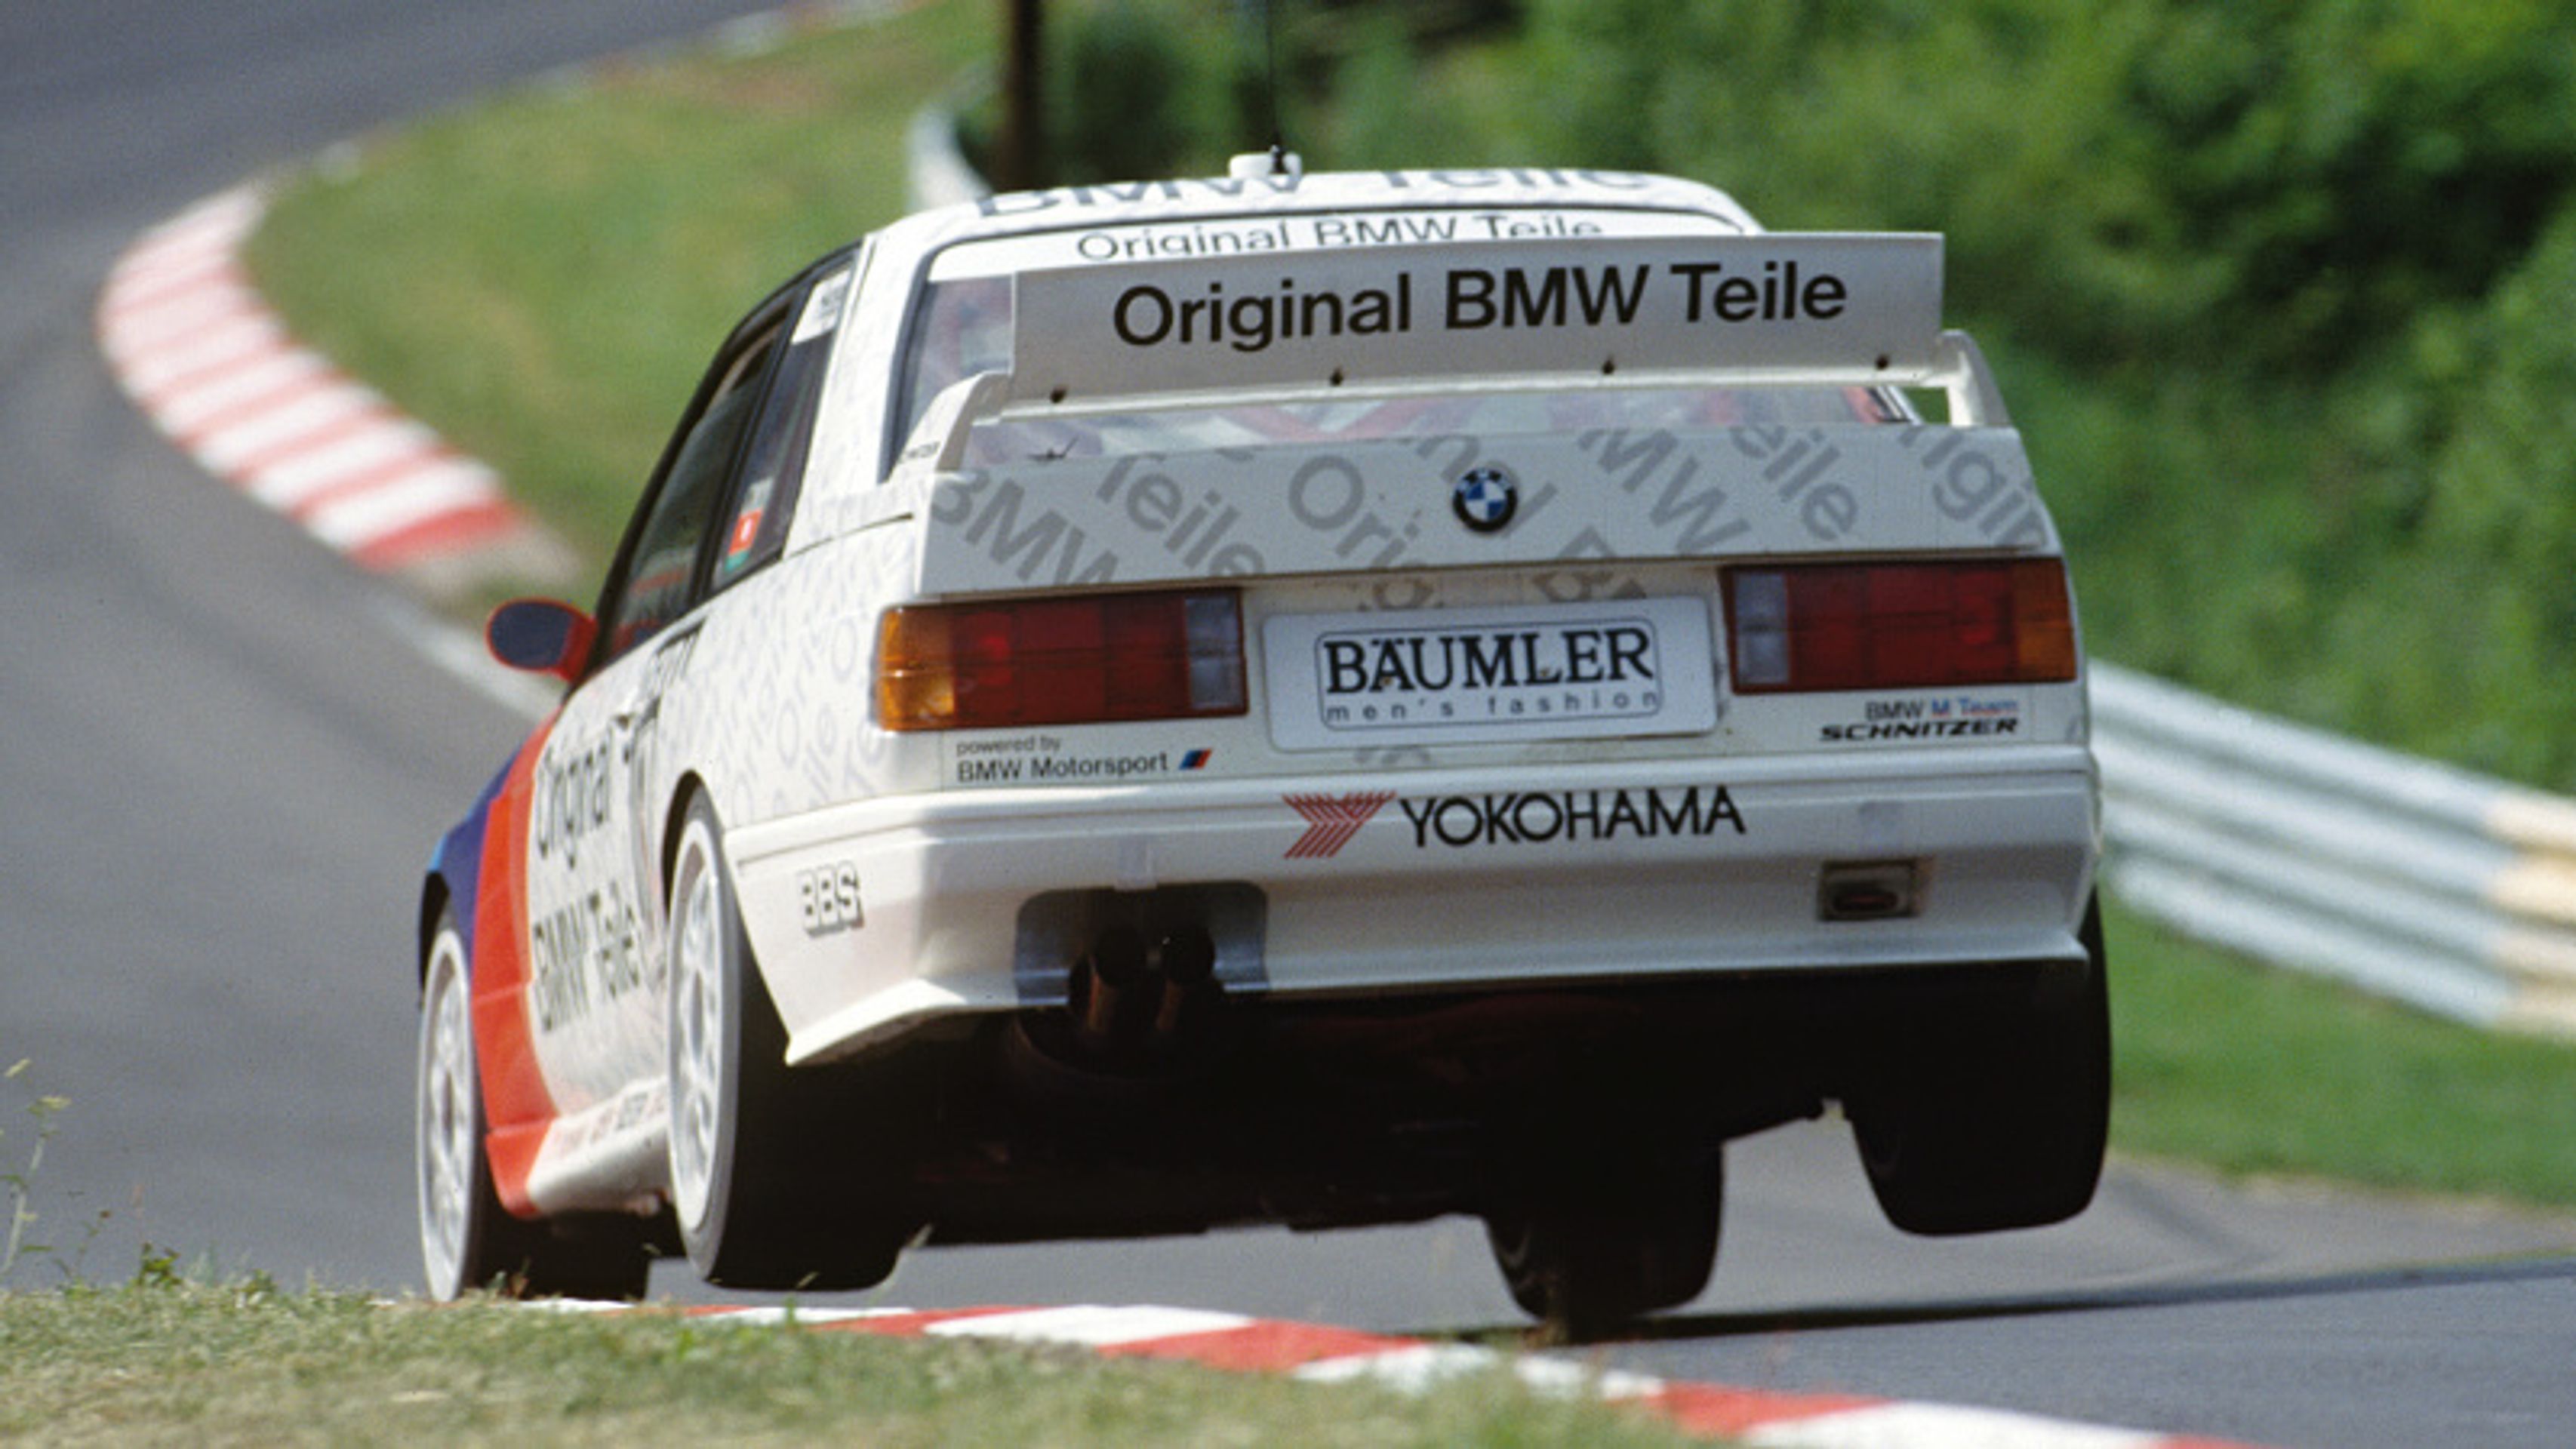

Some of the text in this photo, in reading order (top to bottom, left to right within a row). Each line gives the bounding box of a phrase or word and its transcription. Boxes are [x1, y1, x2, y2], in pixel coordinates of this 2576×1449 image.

[1314, 217, 1457, 247] BMW
[1113, 261, 1848, 352] Original BMW Teile
[1323, 626, 1654, 694] BÄUMLER
[1326, 690, 1660, 722] men's fashion
[1864, 699, 1924, 721] BMW
[1820, 717, 2019, 742] SCHNITZER
[956, 735, 1061, 757] powered by
[957, 752, 1168, 783] BMW Motorsport
[1400, 785, 1747, 848] YOKOHAMA
